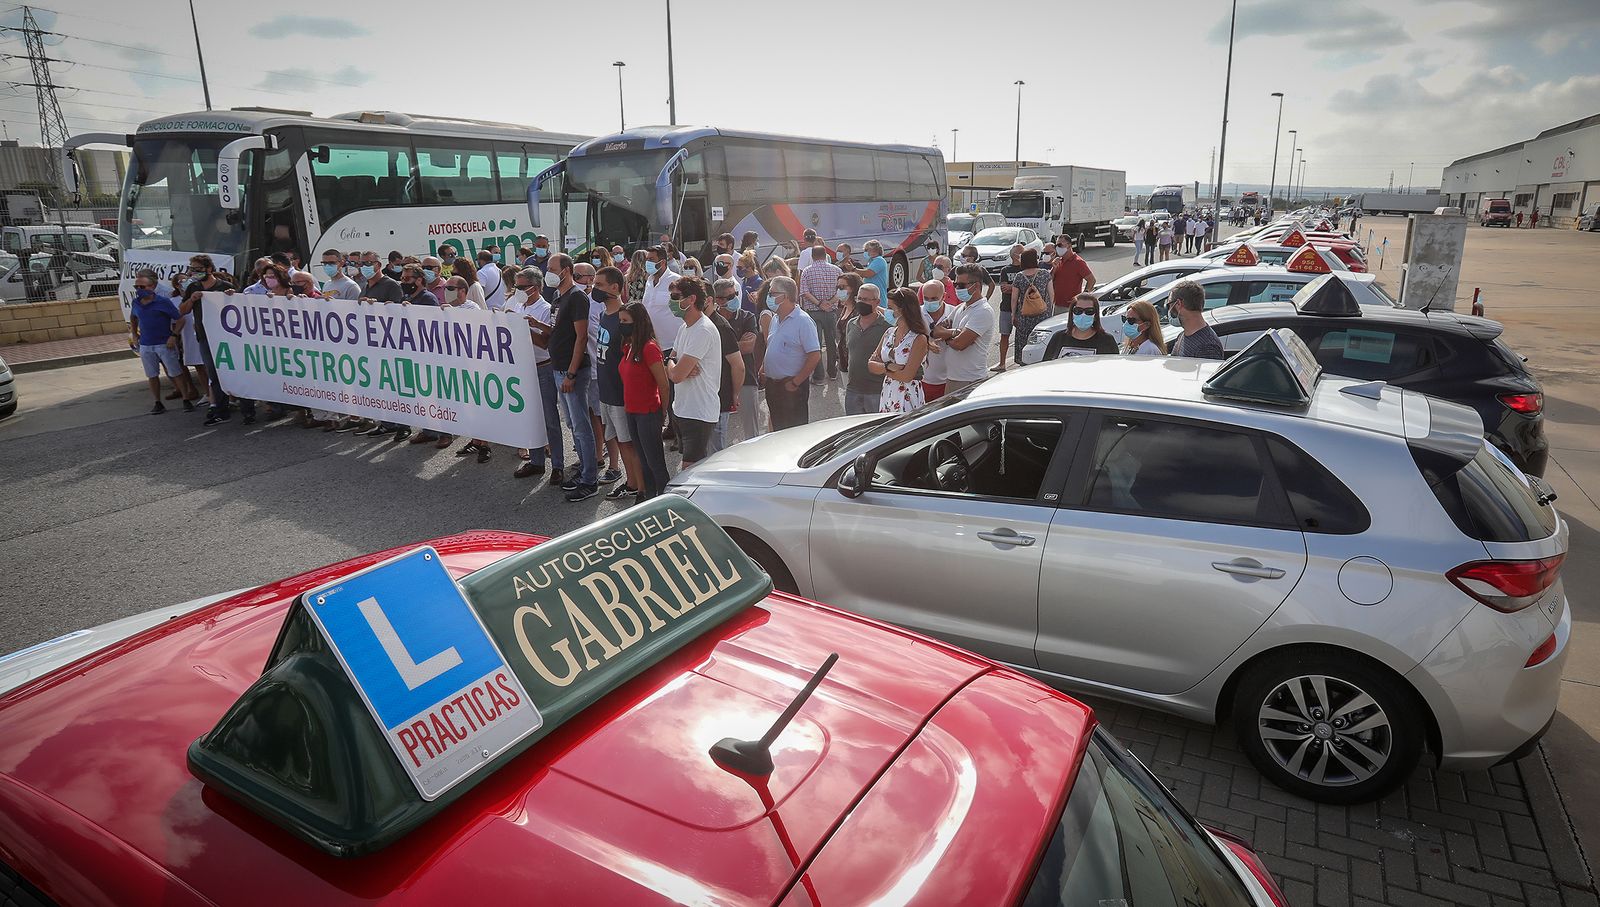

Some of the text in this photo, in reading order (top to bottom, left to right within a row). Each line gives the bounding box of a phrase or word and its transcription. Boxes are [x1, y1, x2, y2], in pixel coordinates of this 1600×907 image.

[174, 121, 186, 130] DE
[187, 120, 244, 131] FORMACION
[428, 221, 488, 236] AUTOESCUELA
[220, 304, 515, 364] QUEREMOS EXAMINAR
[215, 341, 525, 414] A NUESTROS ALUMNOS
[282, 381, 458, 422] Asociaciones de autoescuelas de Cádiz
[512, 508, 685, 599] AUTOESCUELA
[513, 525, 742, 687] GABRIEL
[357, 596, 464, 691] L
[397, 673, 521, 768] PRACTICAS
